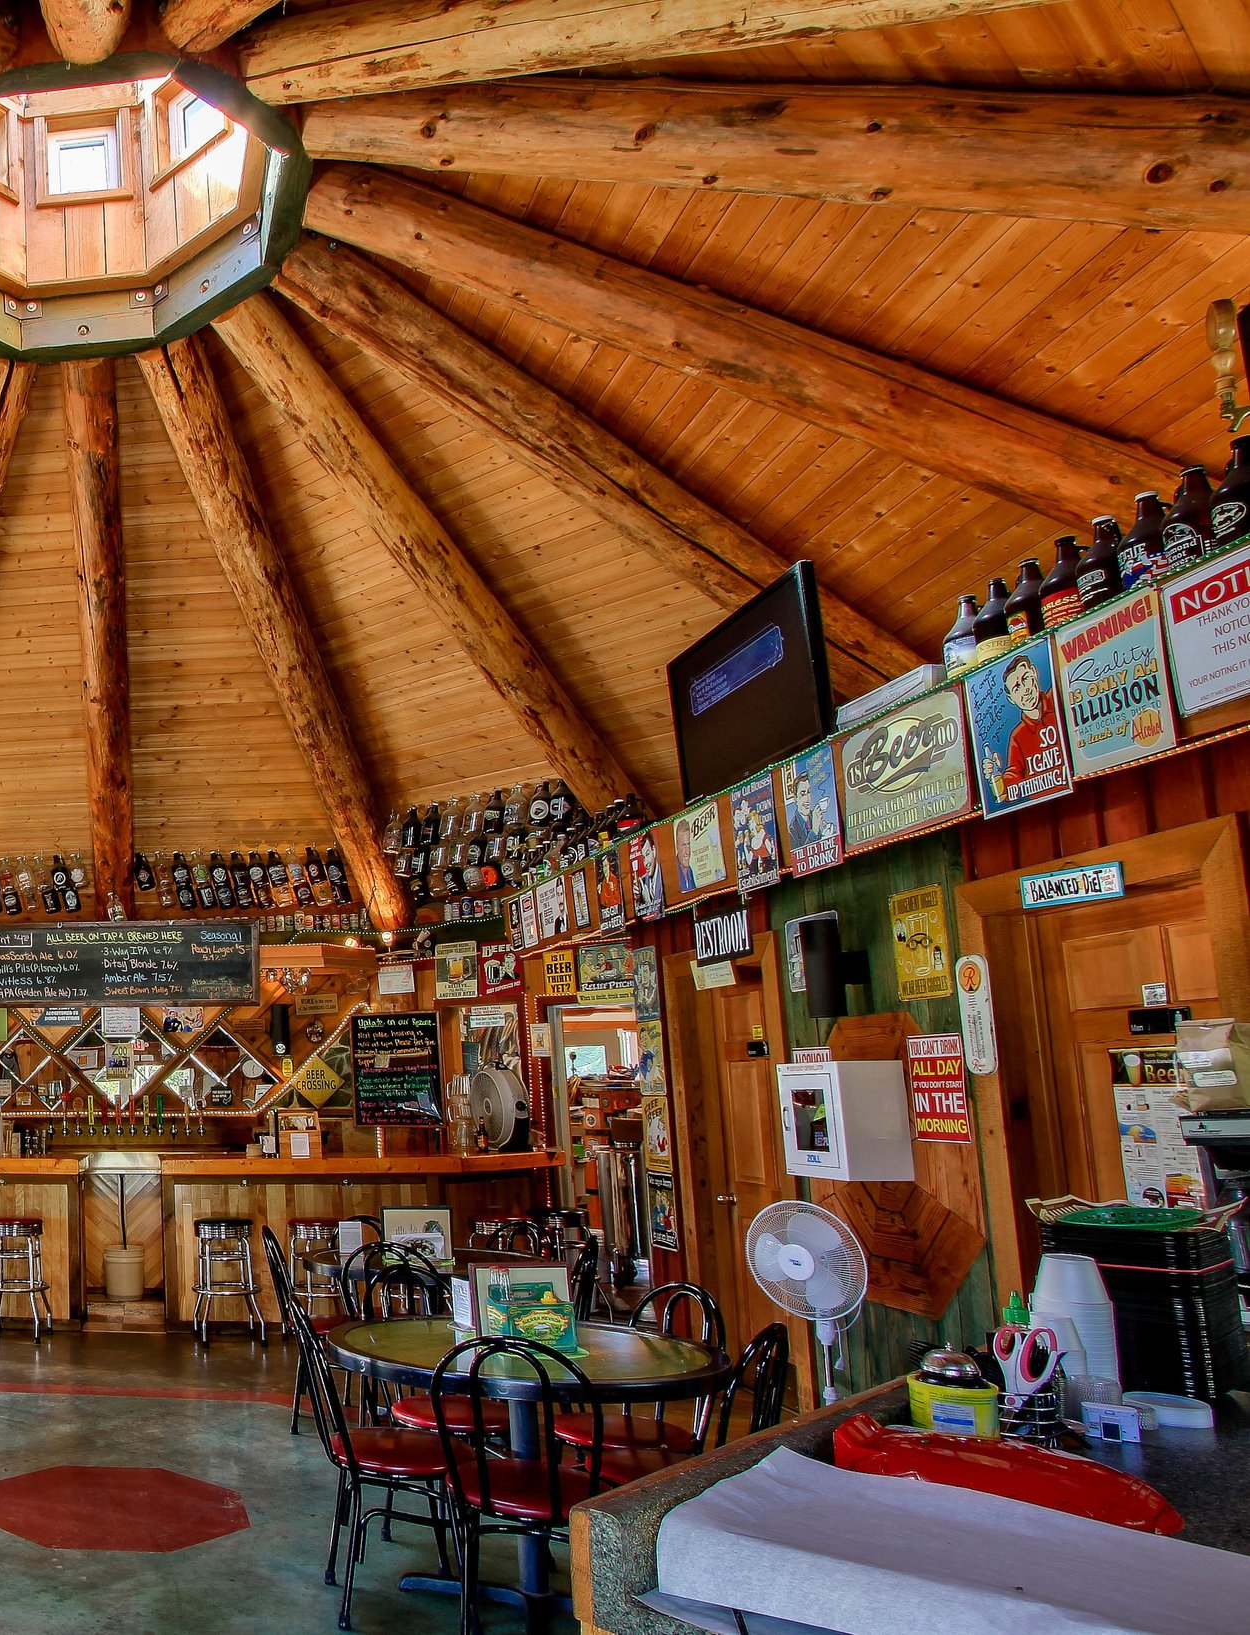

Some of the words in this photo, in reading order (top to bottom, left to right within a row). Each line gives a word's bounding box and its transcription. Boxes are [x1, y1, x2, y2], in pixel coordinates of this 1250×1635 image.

[1197, 605, 1233, 628] THANK
[1061, 594, 1153, 663] WARNING!
[1212, 640, 1236, 656] THIS
[1069, 645, 1155, 687] Reality
[1189, 672, 1209, 688] YOUR
[1209, 663, 1239, 680] NOTING
[1070, 691, 1083, 705] IS
[1088, 669, 1128, 696] ONLY
[1134, 658, 1159, 680] AN
[1071, 674, 1161, 727] ILLUSION
[1074, 725, 1094, 737] THAT
[1095, 712, 1127, 729] OCCURS
[1131, 705, 1147, 717] DUE
[1151, 700, 1162, 710] TO
[1115, 720, 1131, 737] of
[1131, 710, 1164, 743] Alcohol
[1040, 725, 1057, 748] SO
[862, 719, 936, 783] Beer
[1026, 757, 1033, 775] I
[1033, 746, 1062, 772] GAVE
[1007, 784, 1019, 801] UP
[1019, 765, 1068, 797] THINKING!
[848, 803, 883, 828] HELPING
[885, 794, 906, 815] UGLY
[907, 780, 942, 806] PEOPLE
[945, 772, 966, 792] GET
[691, 807, 716, 838] BEER
[856, 823, 875, 841] LAID
[878, 814, 902, 834] SINCE
[903, 807, 920, 824] THE
[922, 794, 956, 817] 1800'S
[820, 837, 836, 851] TIME
[796, 862, 807, 873] TO
[809, 845, 839, 870] DRINK!
[46, 933, 63, 943] ALL
[65, 932, 86, 942] BEER
[89, 932, 99, 940] ON
[100, 932, 118, 941] TAP
[127, 931, 159, 941] BREWED
[161, 931, 184, 941] HERE
[200, 931, 242, 942] Seasonal
[695, 910, 750, 960] RESTROOM
[39, 951, 54, 960] Ale
[130, 946, 149, 956] IPA
[213, 944, 234, 957] Lager
[130, 958, 158, 969] Blonde
[546, 962, 572, 975] BEER
[104, 973, 132, 983] Amber
[133, 971, 148, 983] Ale
[547, 974, 572, 983] THIRTY
[551, 983, 571, 993] YET?
[910, 1042, 921, 1056] YOU
[922, 1040, 939, 1055] CAN'T
[940, 1039, 958, 1054] DRINK
[305, 1069, 326, 1080] BEER
[913, 1060, 935, 1076] ALL
[936, 1060, 961, 1075] DAY
[296, 1080, 337, 1090] CROSSING
[916, 1093, 930, 1113] IN
[931, 1092, 965, 1114] THE
[917, 1118, 968, 1134] MORNING
